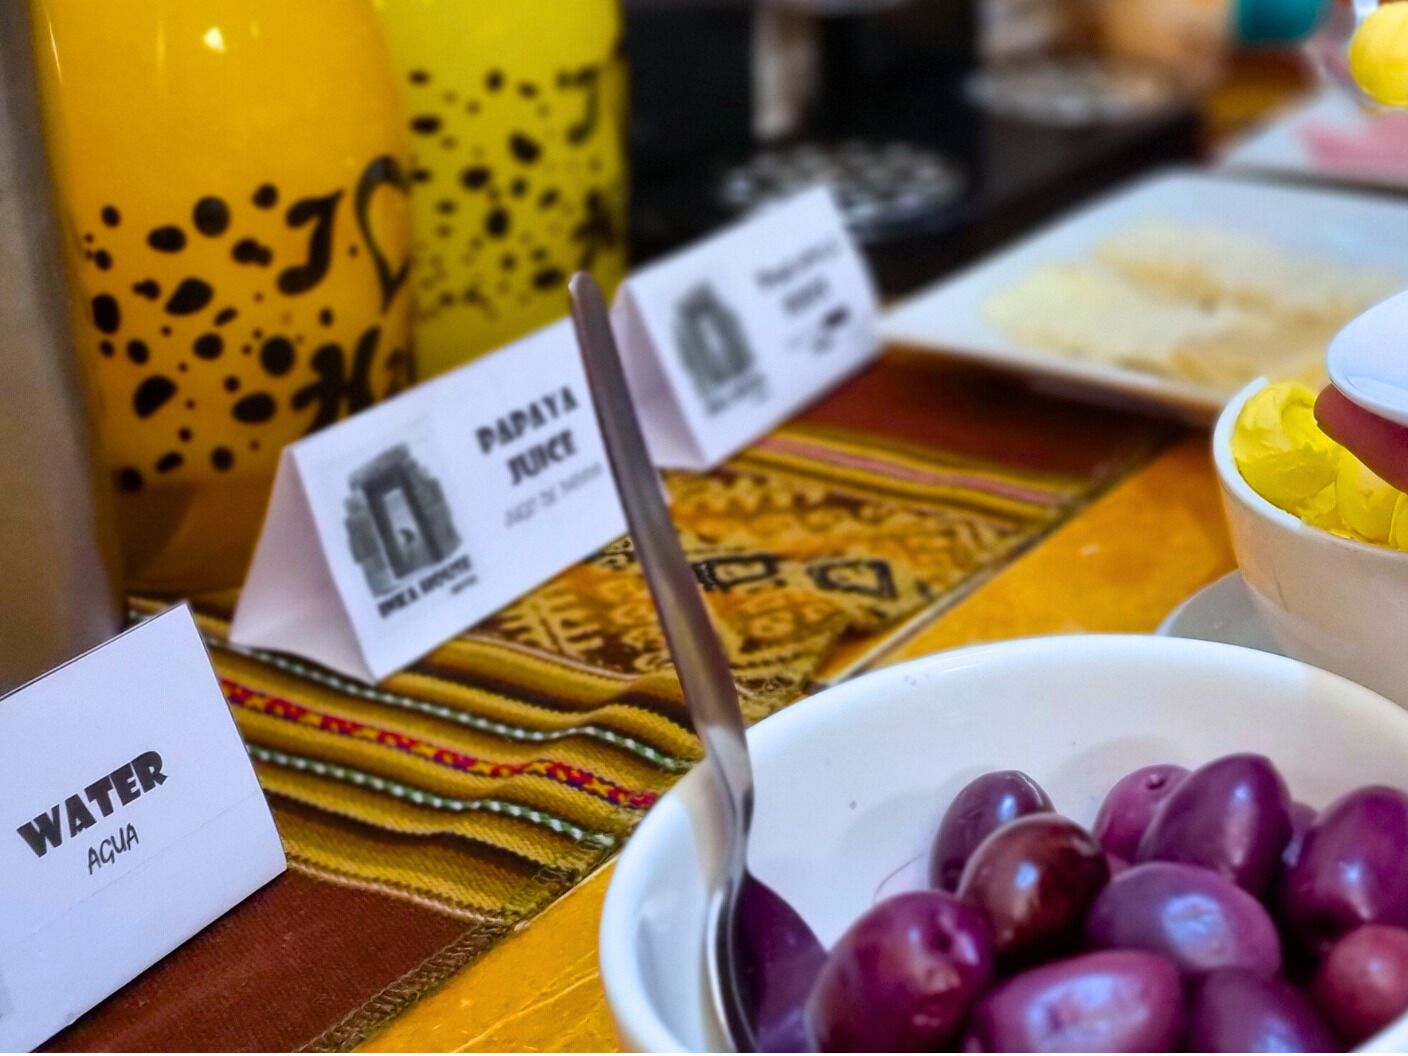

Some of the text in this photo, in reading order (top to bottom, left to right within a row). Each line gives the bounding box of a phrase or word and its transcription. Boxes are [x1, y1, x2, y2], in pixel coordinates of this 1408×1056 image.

[475, 385, 578, 455] PAPAYA
[506, 429, 577, 485] JUICE
[16, 751, 168, 858] WATER
[88, 823, 139, 875] AGUA
